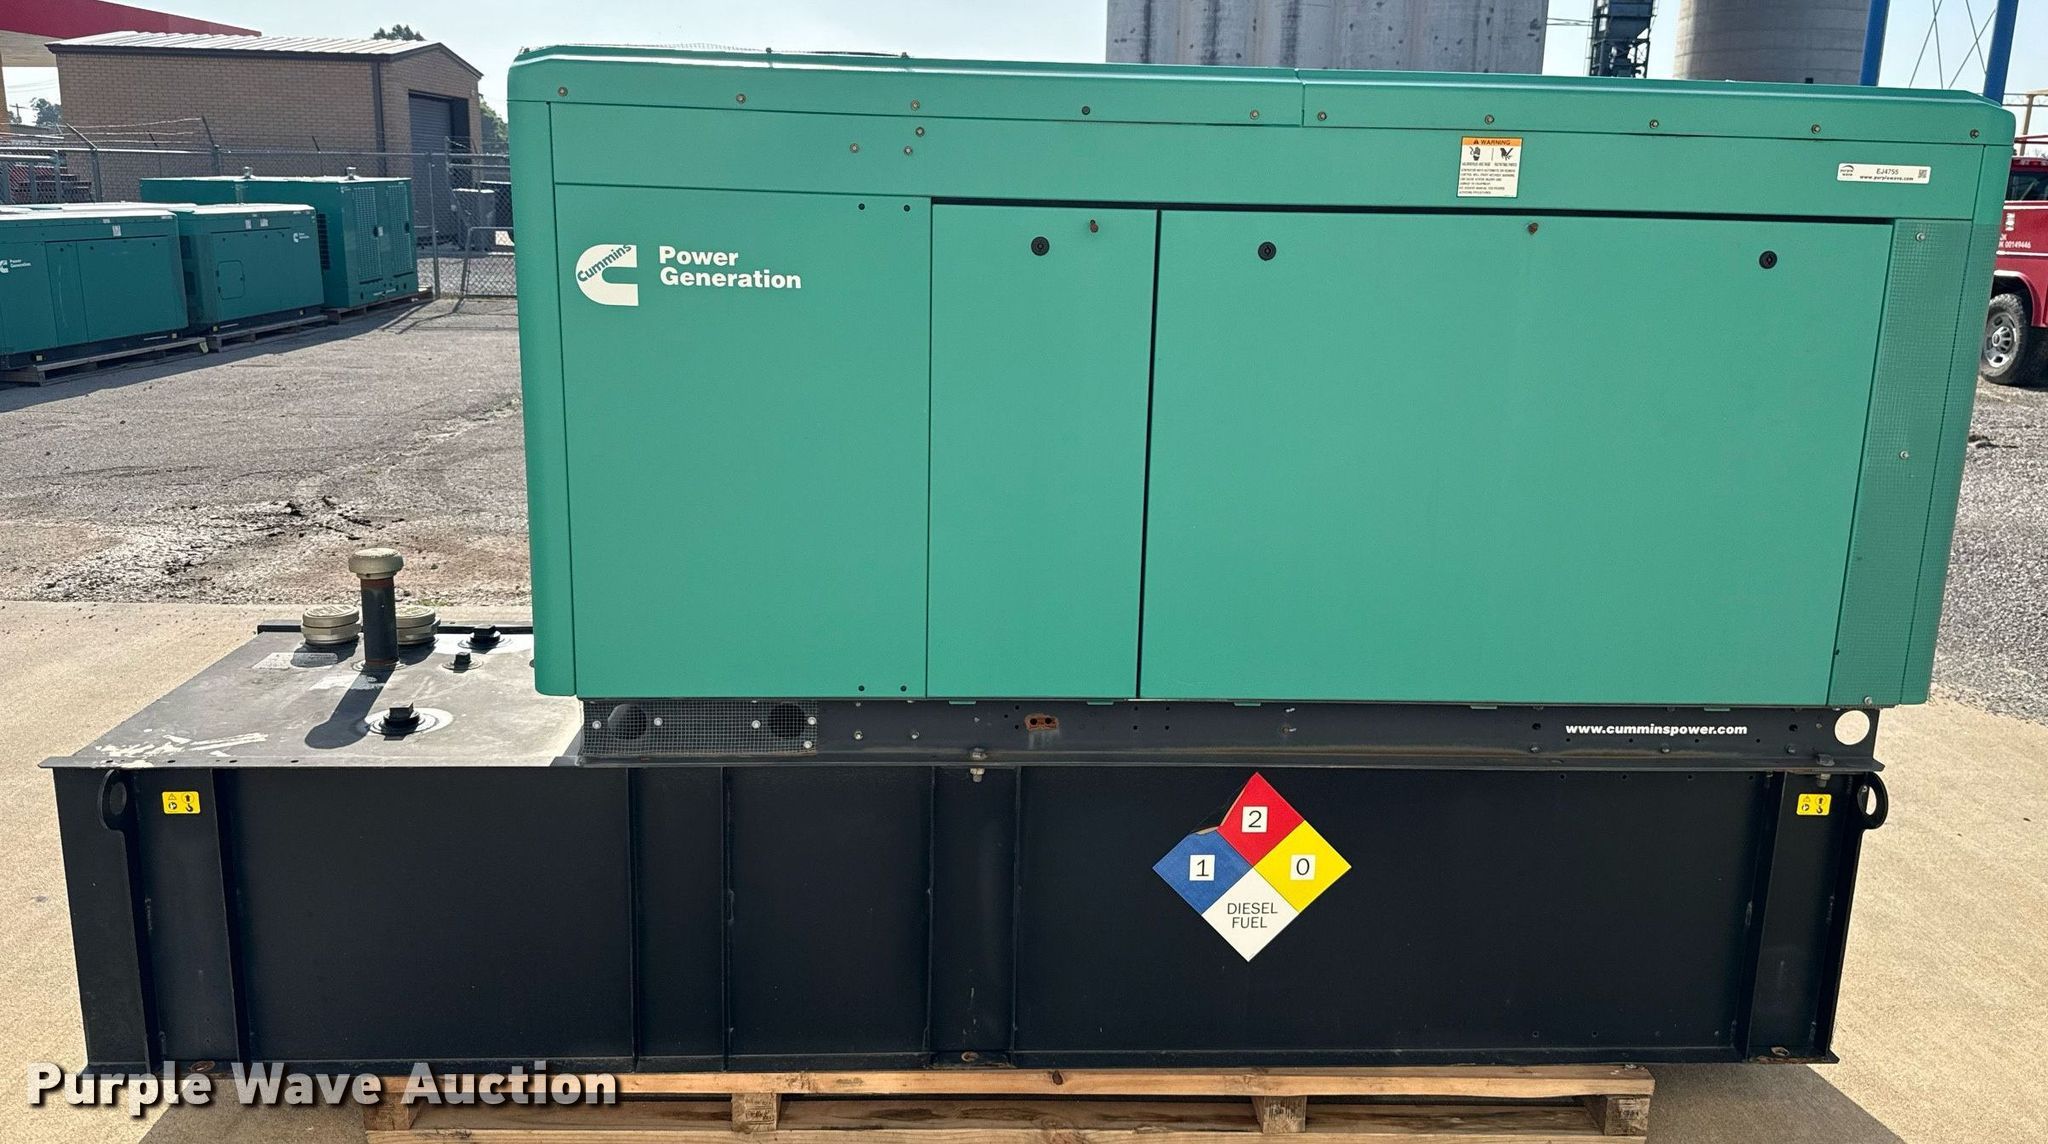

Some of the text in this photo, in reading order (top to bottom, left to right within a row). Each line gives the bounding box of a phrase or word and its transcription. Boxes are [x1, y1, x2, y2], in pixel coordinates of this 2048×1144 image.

[577, 244, 632, 282] Cummins
[659, 245, 739, 266] Power
[660, 267, 802, 289] Generation
[1565, 723, 1748, 736] www.cumminspower.com
[1248, 810, 1262, 828] 2
[1196, 859, 1209, 877] 1
[1296, 858, 1310, 876] 0
[1227, 902, 1278, 915] DIESEL
[1231, 916, 1268, 929] FUEL
